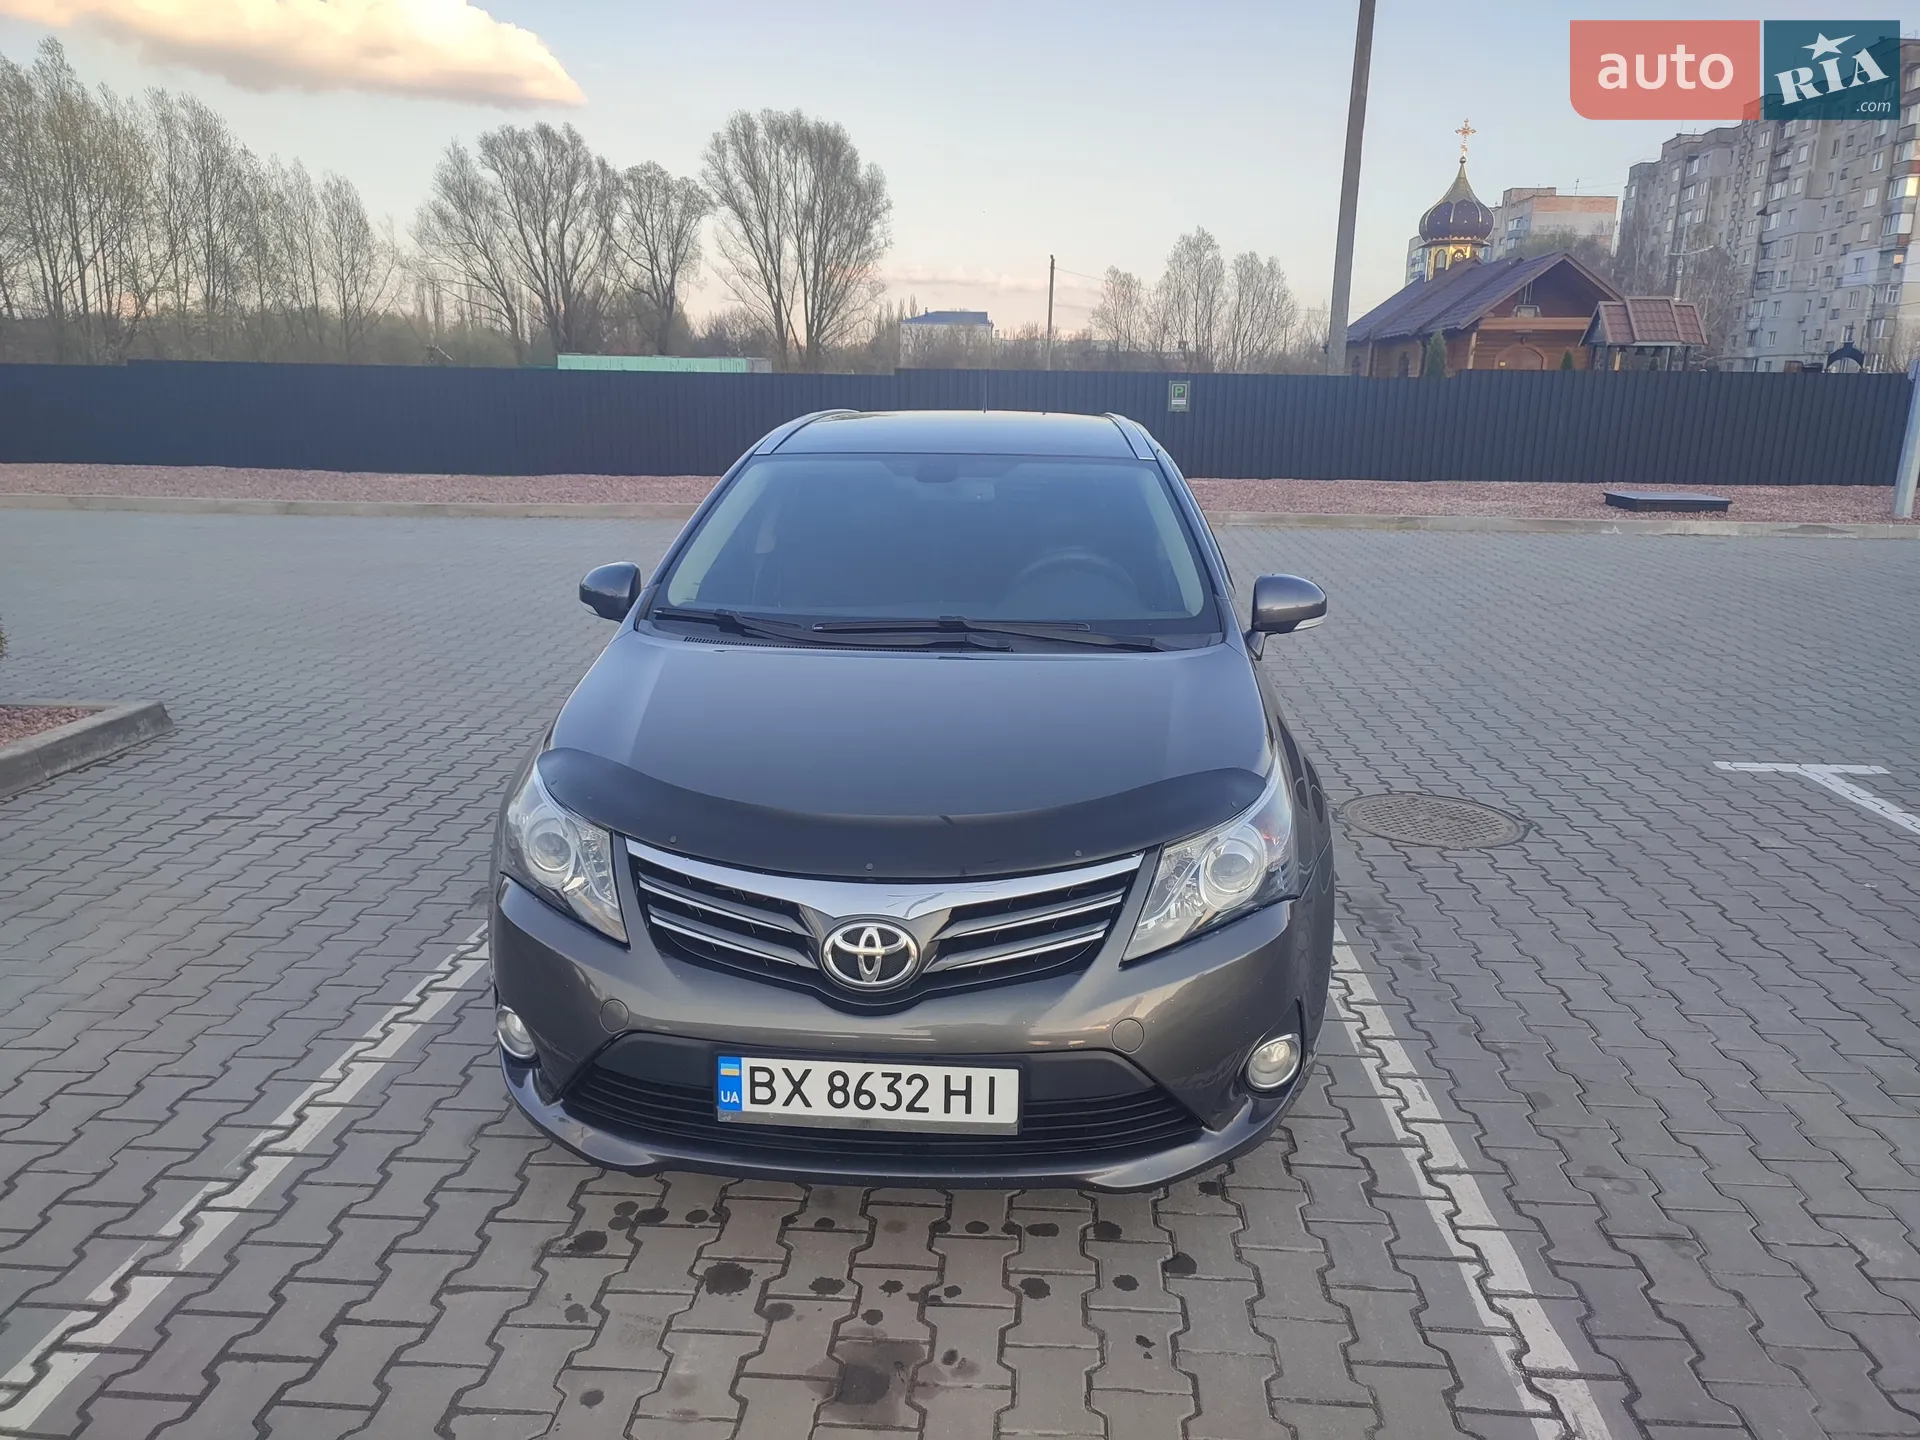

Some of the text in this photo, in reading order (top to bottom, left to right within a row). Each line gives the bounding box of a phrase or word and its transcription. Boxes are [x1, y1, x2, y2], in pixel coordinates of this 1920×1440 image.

[720, 1090, 740, 1104] UA
[749, 1065, 996, 1115] BX 8632 HI
